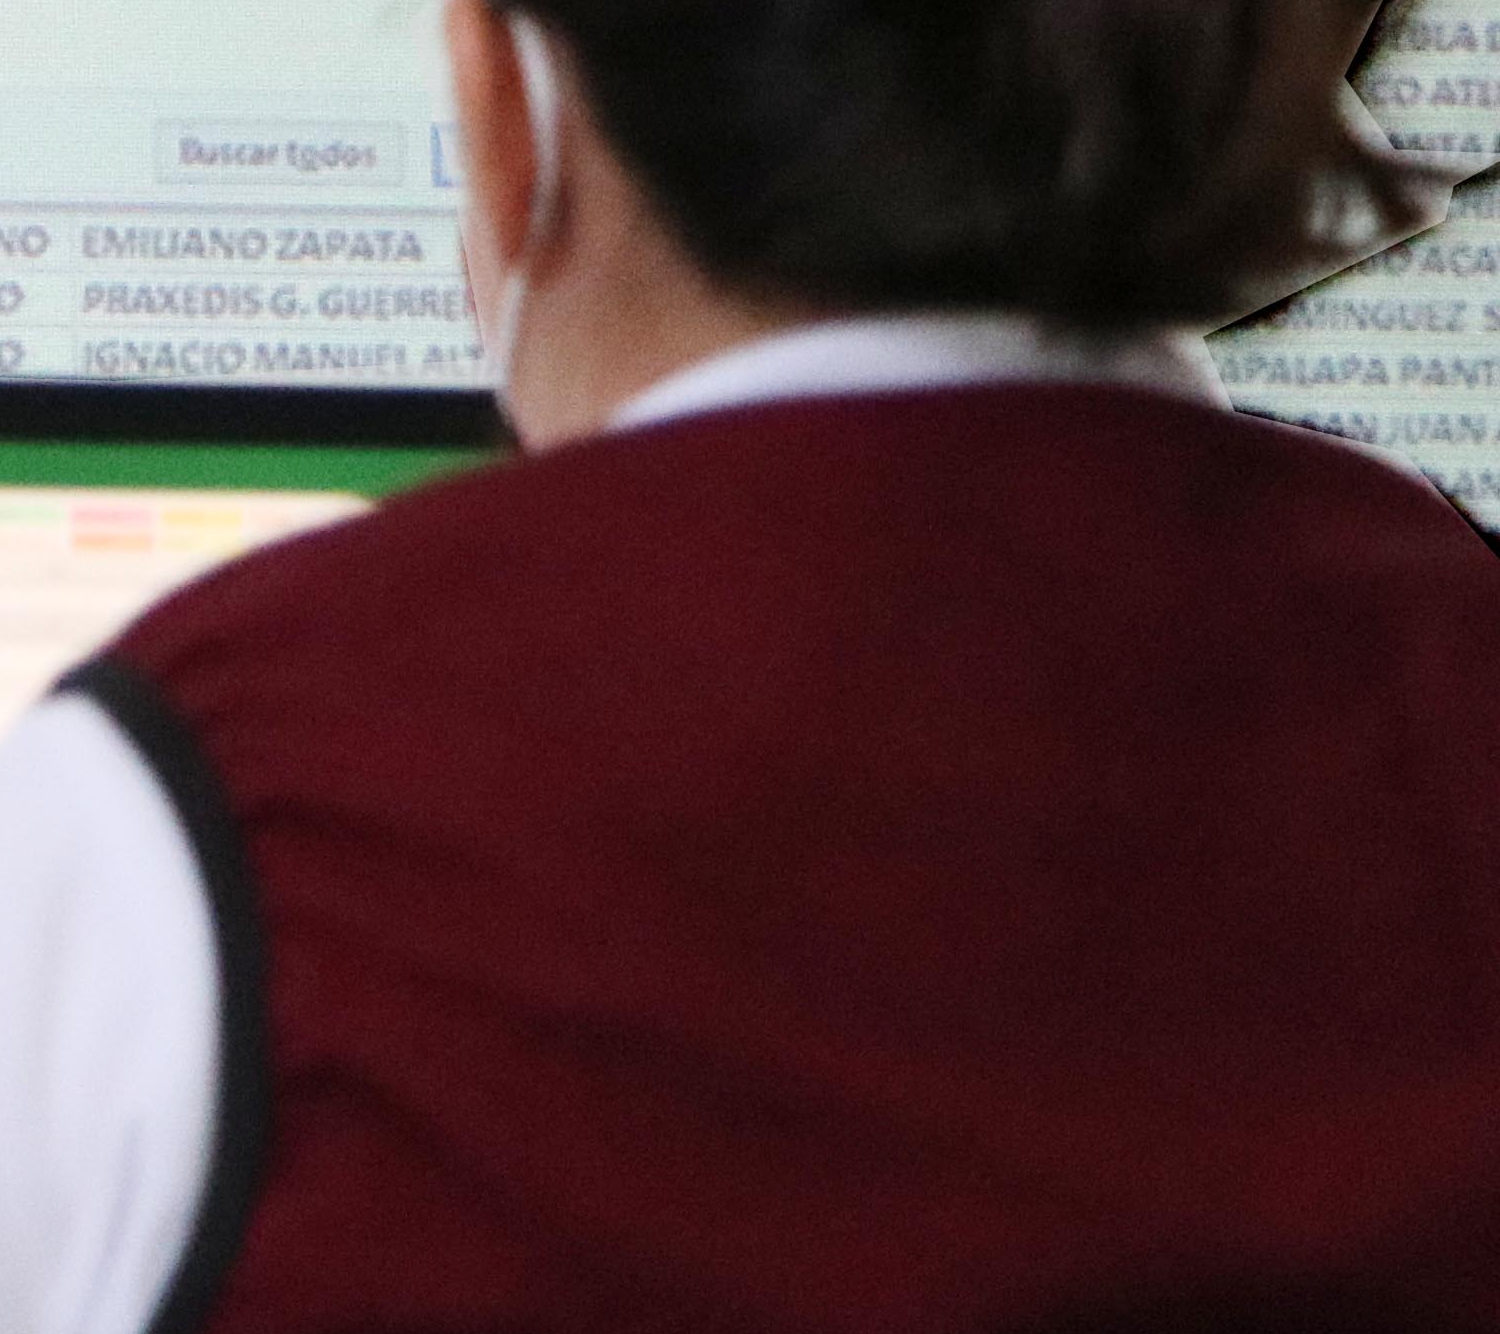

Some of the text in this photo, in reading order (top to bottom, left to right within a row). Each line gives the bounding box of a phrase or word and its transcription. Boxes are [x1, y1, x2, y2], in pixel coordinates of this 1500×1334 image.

[179, 135, 376, 173] Buscar todos
[82, 225, 270, 262] EMILIANO
[275, 226, 425, 262] ZAPATA
[83, 281, 270, 319] PRAXEDIS
